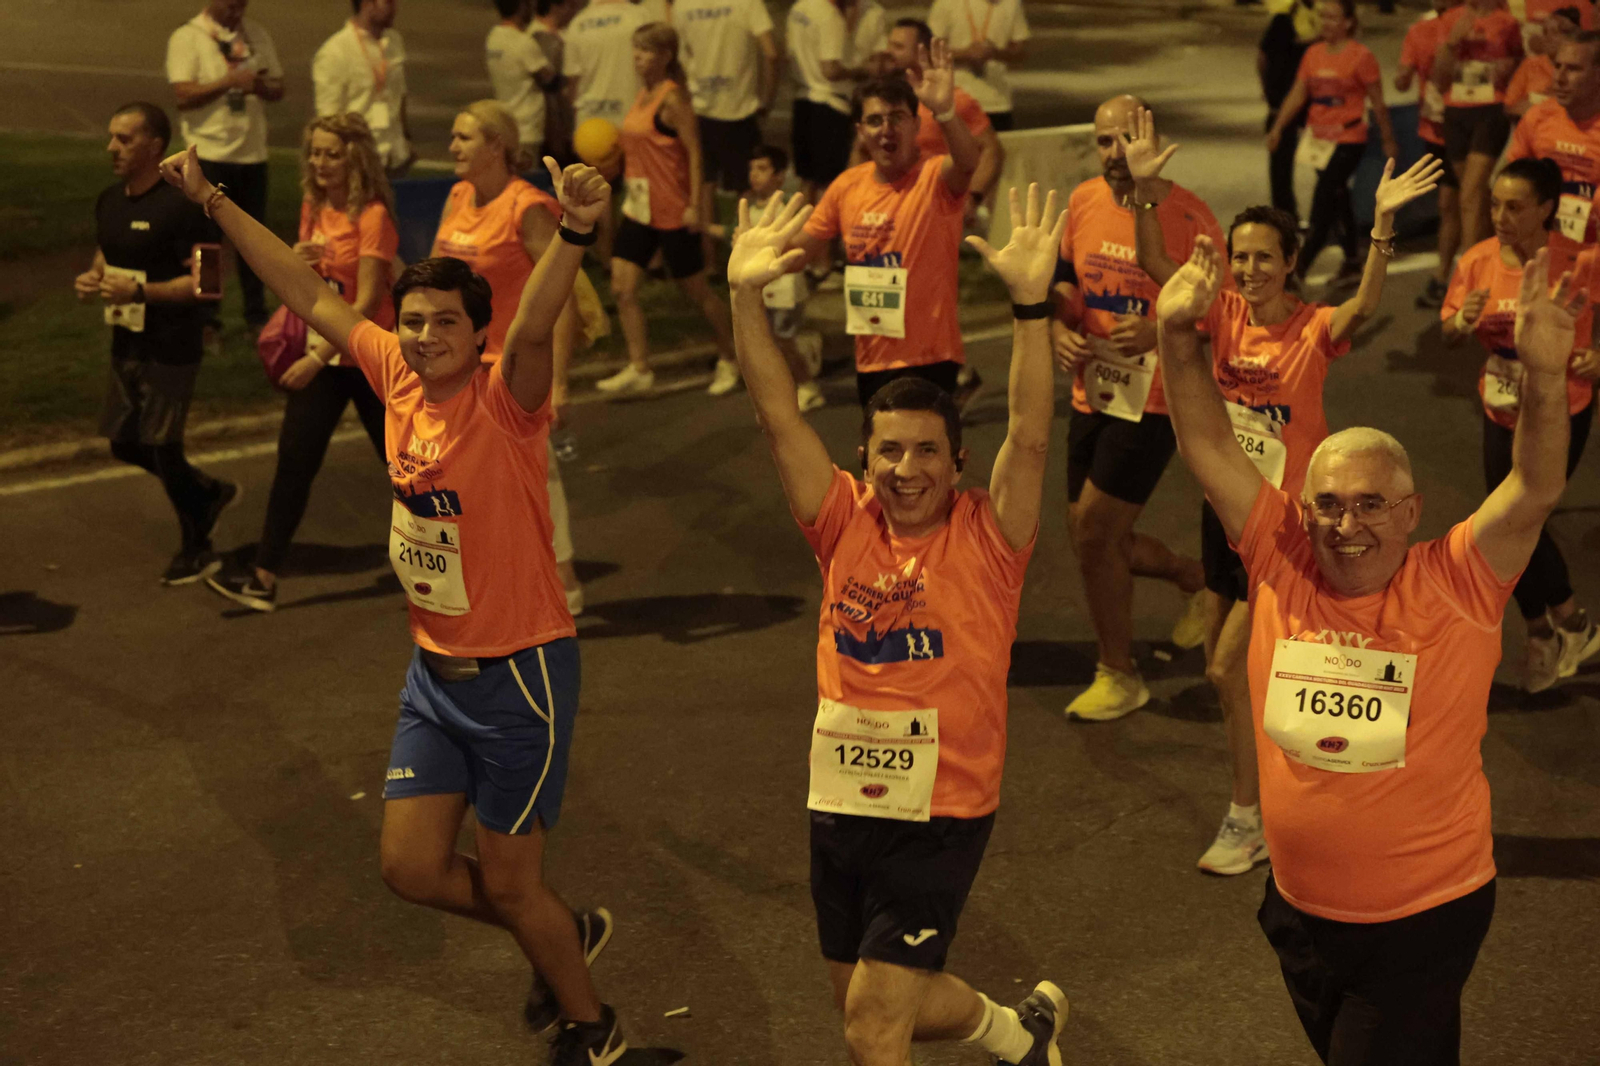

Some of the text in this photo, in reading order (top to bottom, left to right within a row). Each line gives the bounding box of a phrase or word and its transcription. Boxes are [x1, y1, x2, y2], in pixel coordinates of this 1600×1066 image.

[1100, 241, 1136, 260] XXXV
[861, 291, 885, 307] 641
[399, 542, 447, 573] 21130
[847, 575, 884, 601] CARRER
[1295, 687, 1382, 722] 16360
[835, 744, 914, 771] 12529
